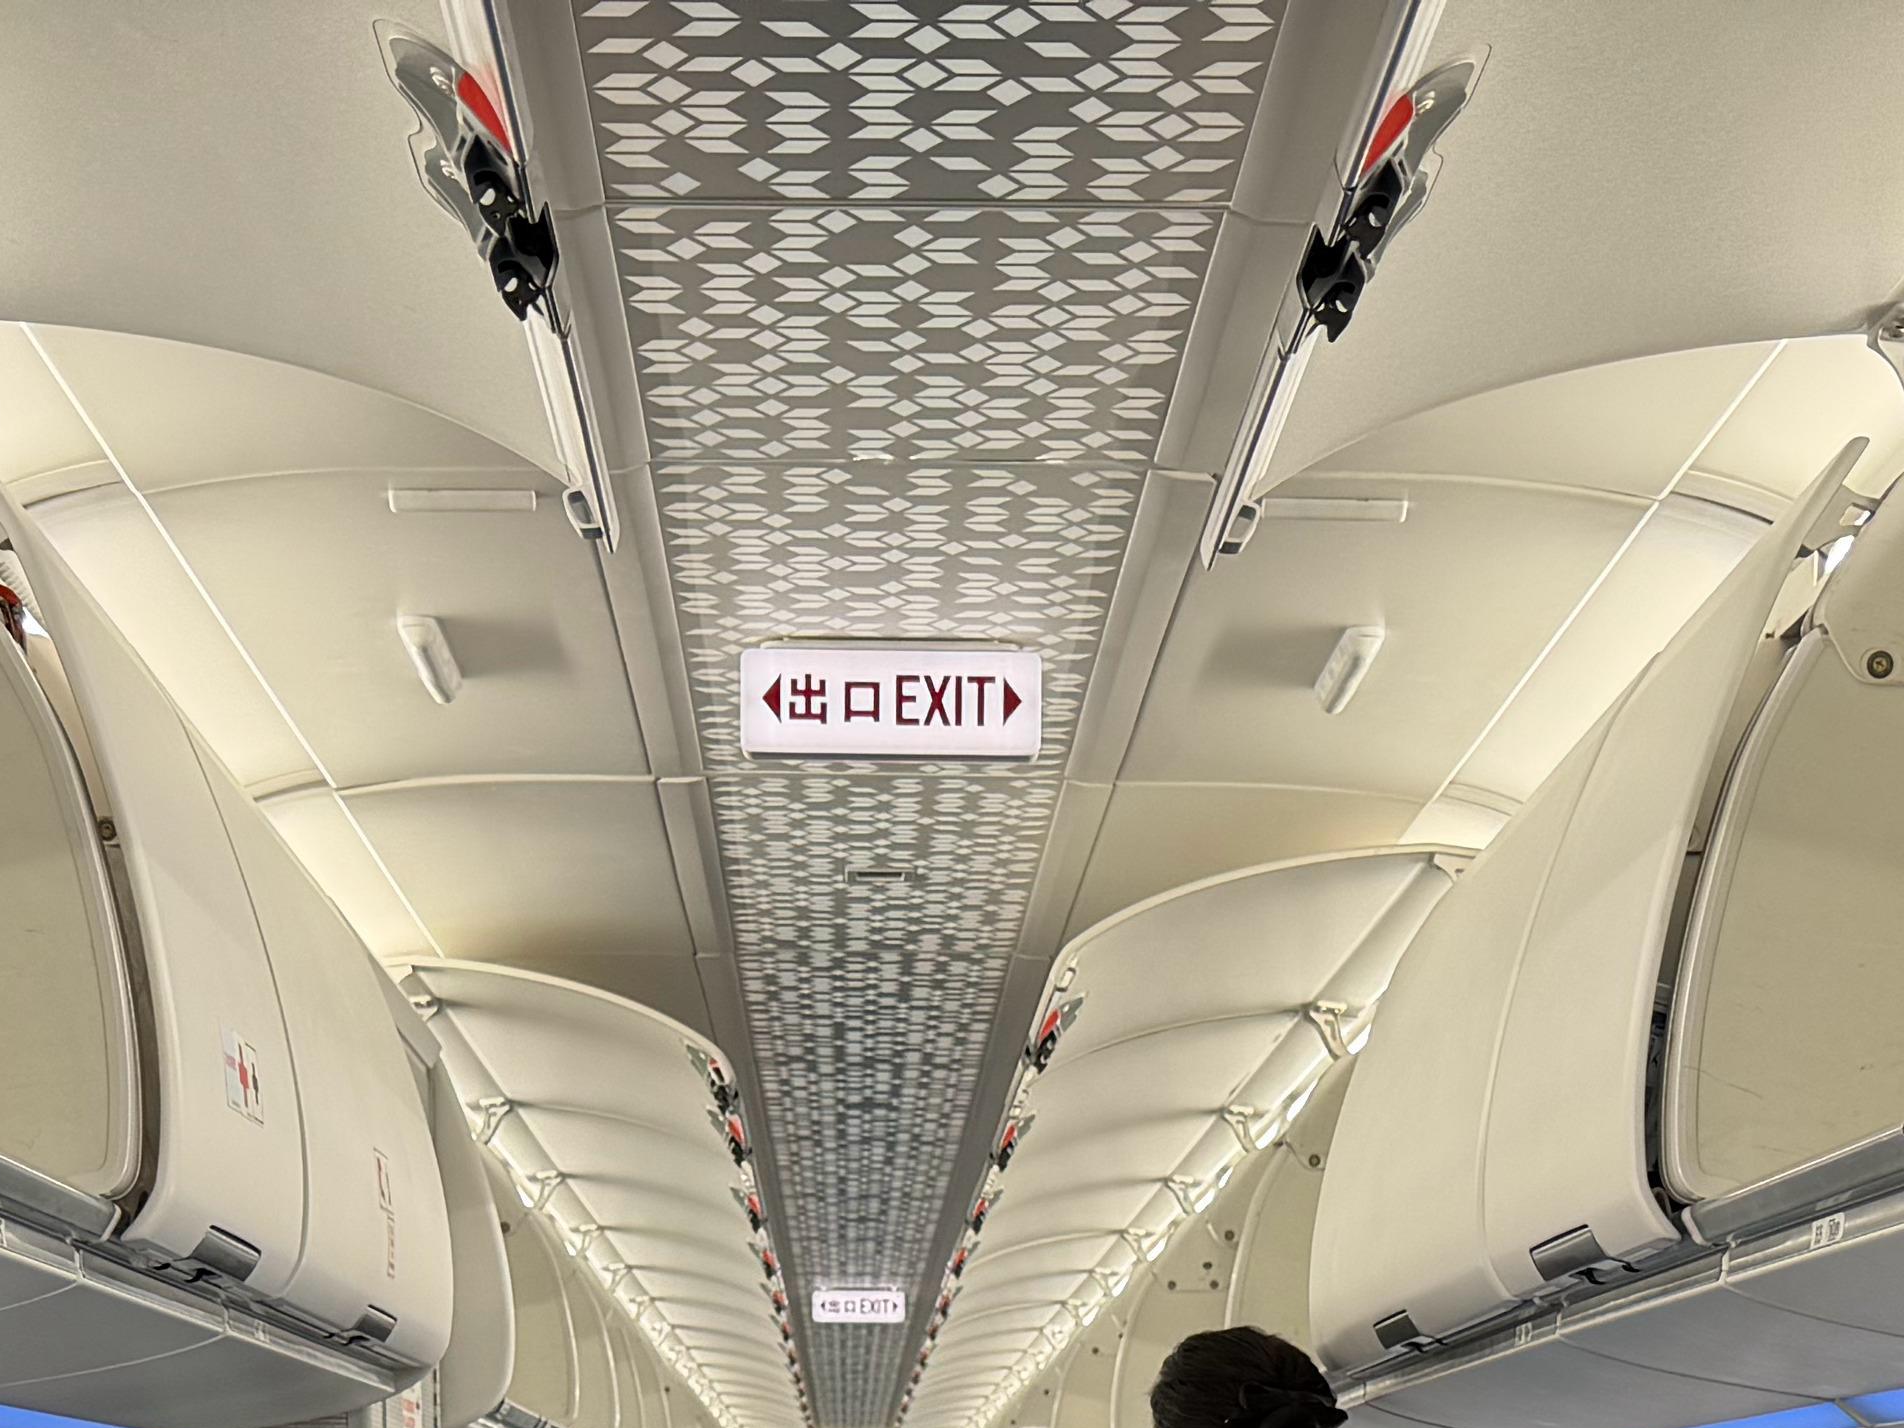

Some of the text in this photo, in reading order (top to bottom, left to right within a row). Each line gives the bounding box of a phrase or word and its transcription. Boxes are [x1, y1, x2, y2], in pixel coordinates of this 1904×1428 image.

[789, 674, 996, 726] 出口 EXIT
[860, 1298, 891, 1314] EXIT
